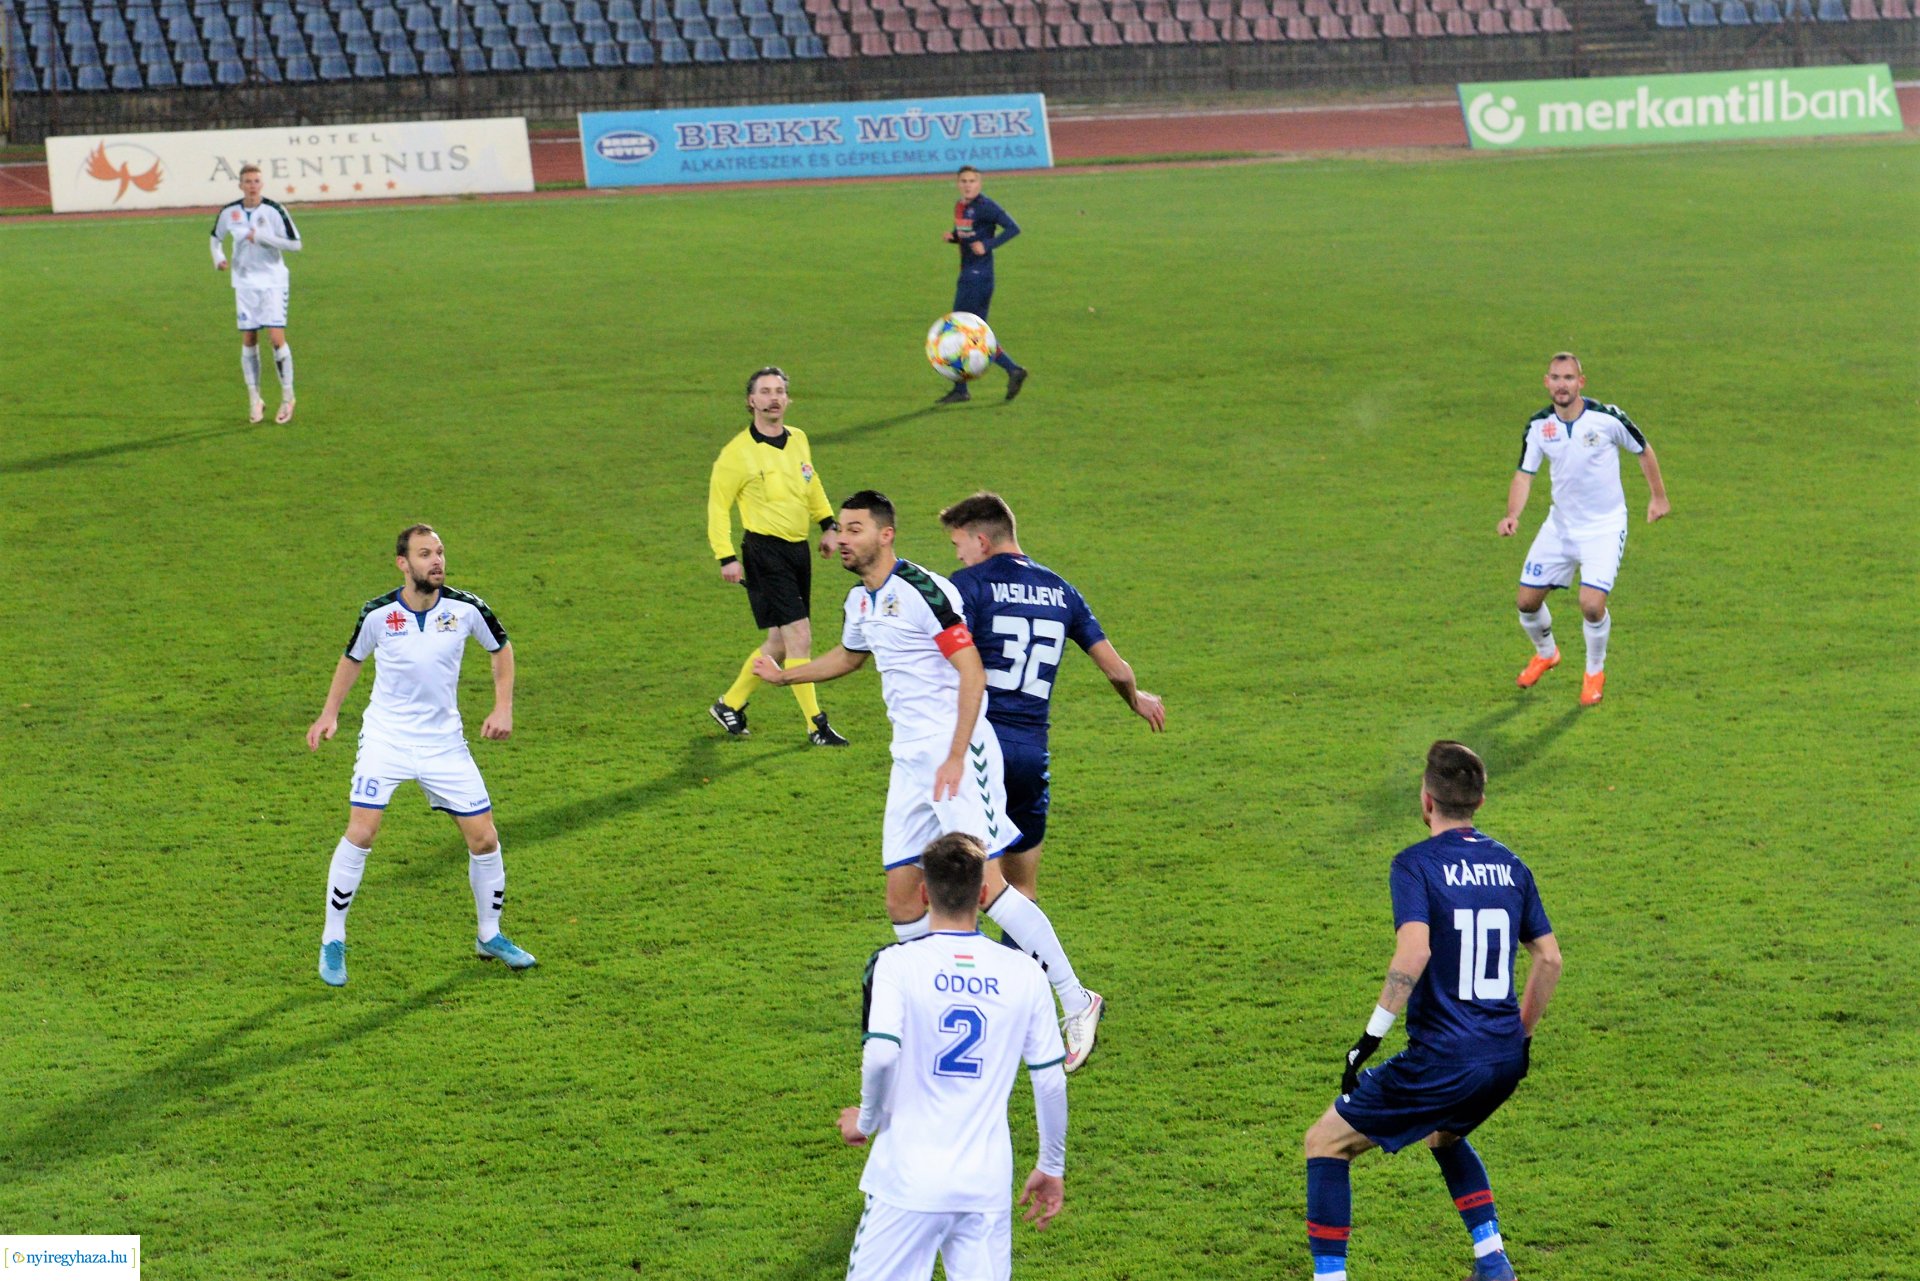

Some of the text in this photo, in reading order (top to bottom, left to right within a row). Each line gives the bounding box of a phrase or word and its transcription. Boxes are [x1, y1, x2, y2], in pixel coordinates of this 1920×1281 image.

[289, 132, 382, 146] HOTEL
[675, 119, 842, 150] BREKK
[681, 144, 1037, 172] ALKATRÉSZEK ÉS GÉPELEMEK GYÁRTÁSA
[986, 615, 1065, 700] 32
[354, 776, 379, 798] 16
[1454, 908, 1510, 1001] 10
[933, 1004, 987, 1079] 2
